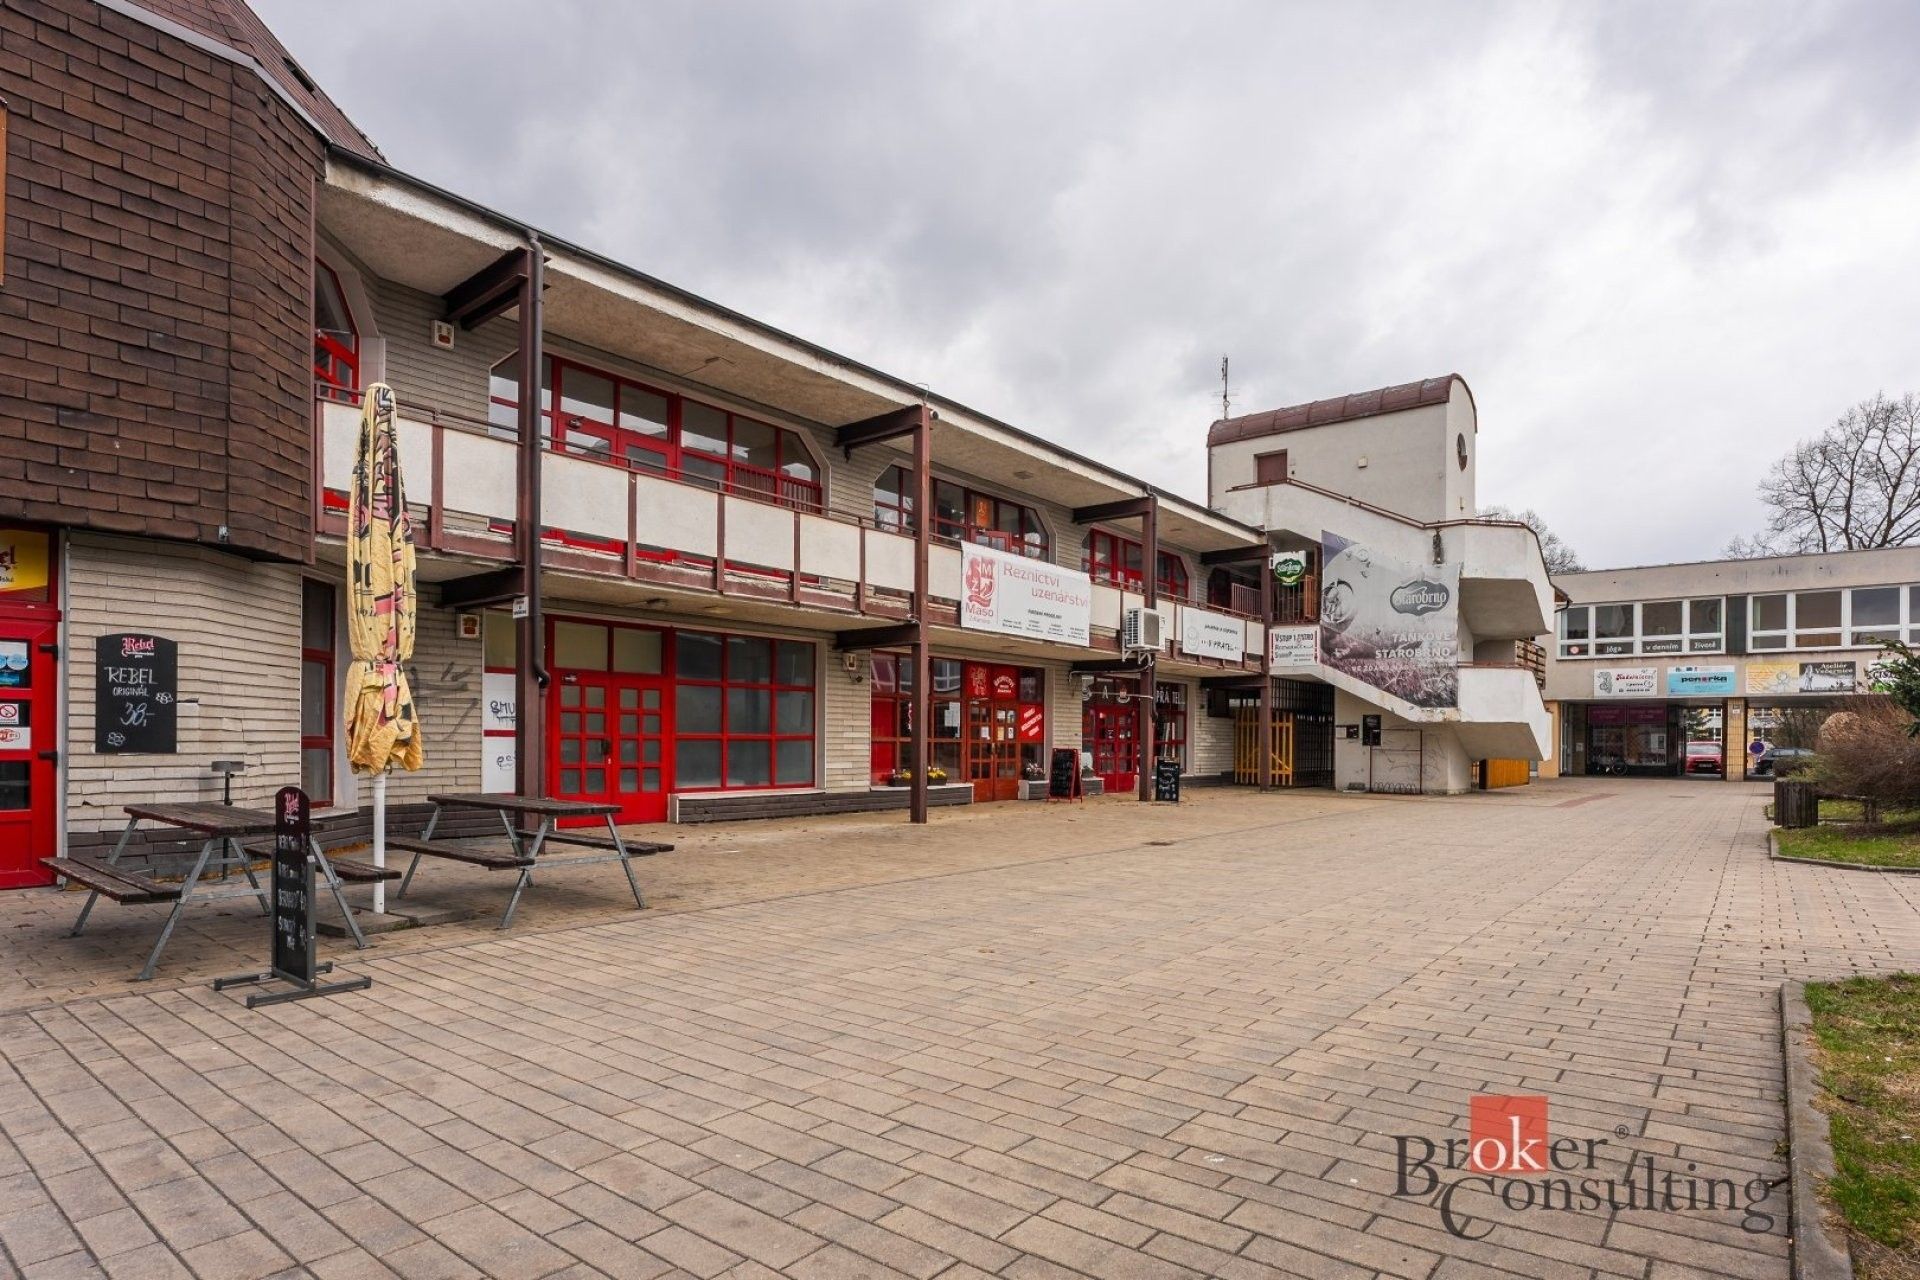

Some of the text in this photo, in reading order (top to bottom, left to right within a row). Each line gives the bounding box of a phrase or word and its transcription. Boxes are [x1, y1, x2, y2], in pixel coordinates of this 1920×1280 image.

[965, 602, 993, 617] Maso
[122, 637, 155, 652] Rebel
[1375, 647, 1450, 659] STAROBRNO
[104, 666, 159, 685] REBEL
[112, 685, 150, 697] ORIGINÁL
